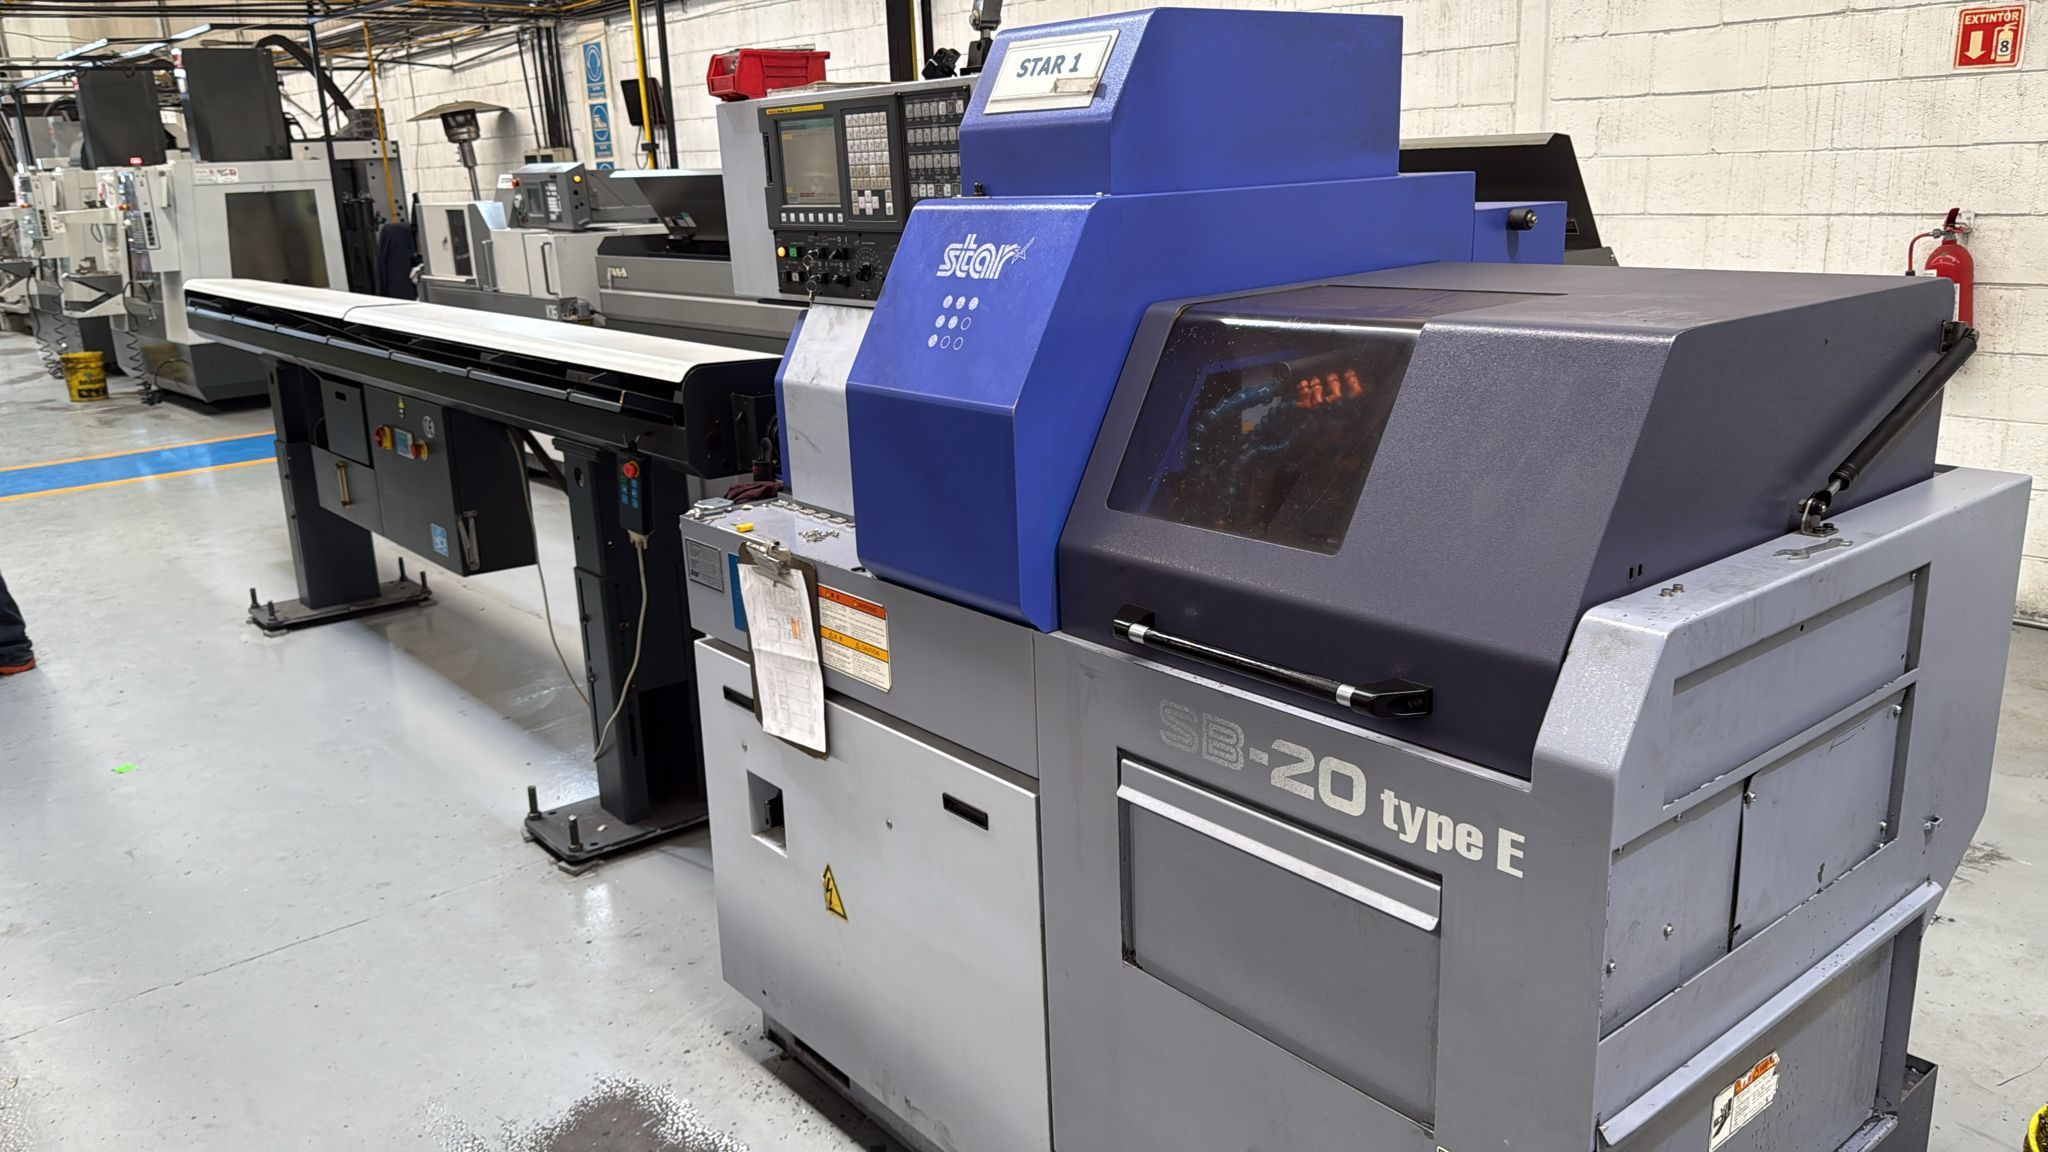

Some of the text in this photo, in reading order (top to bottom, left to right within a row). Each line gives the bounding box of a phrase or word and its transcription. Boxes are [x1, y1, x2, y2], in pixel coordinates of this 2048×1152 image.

[1999, 40, 2010, 53] 8
[1016, 52, 1082, 78] STAR 1
[936, 233, 1026, 279] star
[1159, 698, 1525, 879] SB-20 type E
